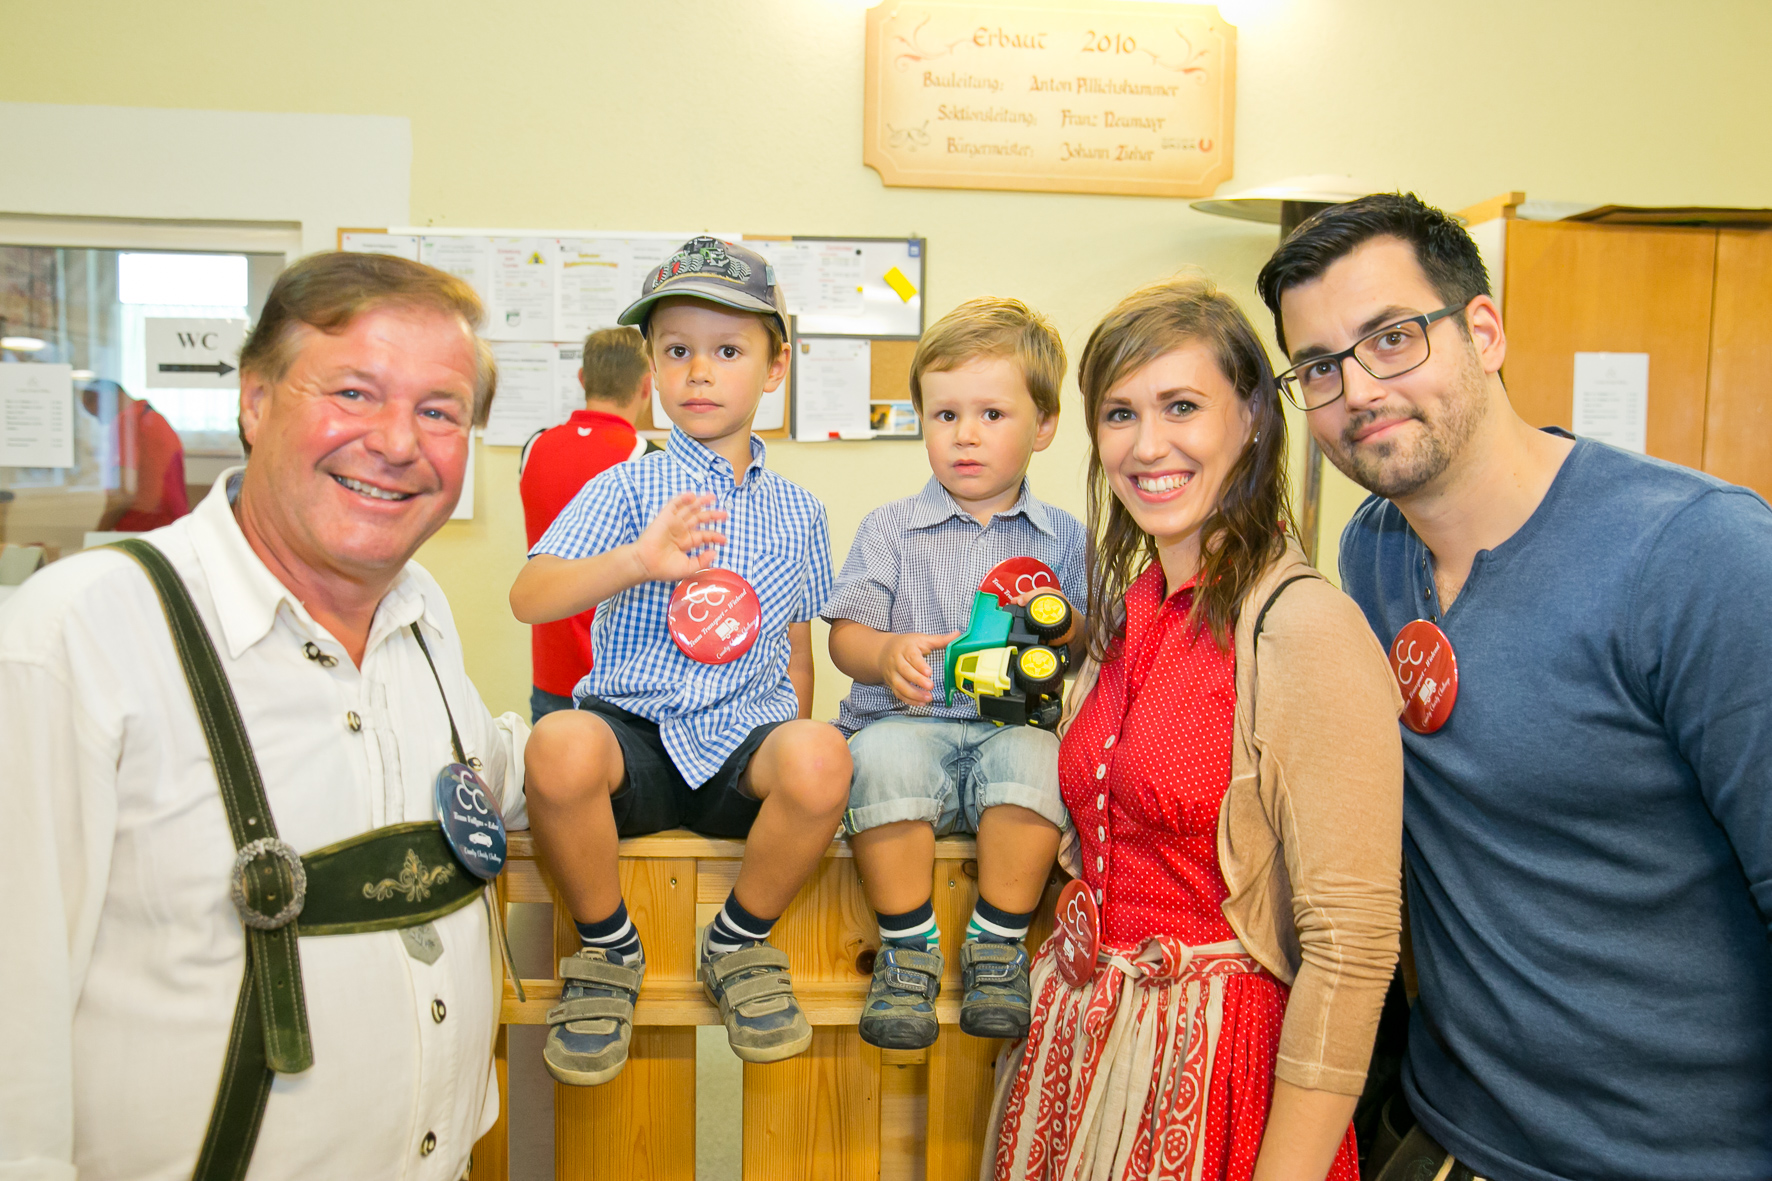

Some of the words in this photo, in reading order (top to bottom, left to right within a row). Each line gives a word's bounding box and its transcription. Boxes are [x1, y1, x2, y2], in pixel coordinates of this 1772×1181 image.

[972, 27, 1048, 51] Erbaut
[1081, 30, 1137, 54] 2010
[922, 71, 1005, 94] Bauleitung:
[1029, 75, 1073, 93] Anton
[1061, 109, 1098, 128] Franz
[1103, 111, 1165, 133] Neumayr
[946, 136, 1033, 158] Bürgermeister:
[1060, 142, 1110, 162] Johann
[177, 331, 219, 351] WC
[992, 578, 1004, 591] Team
[701, 612, 724, 635] Transport
[1409, 671, 1424, 698] Transport
